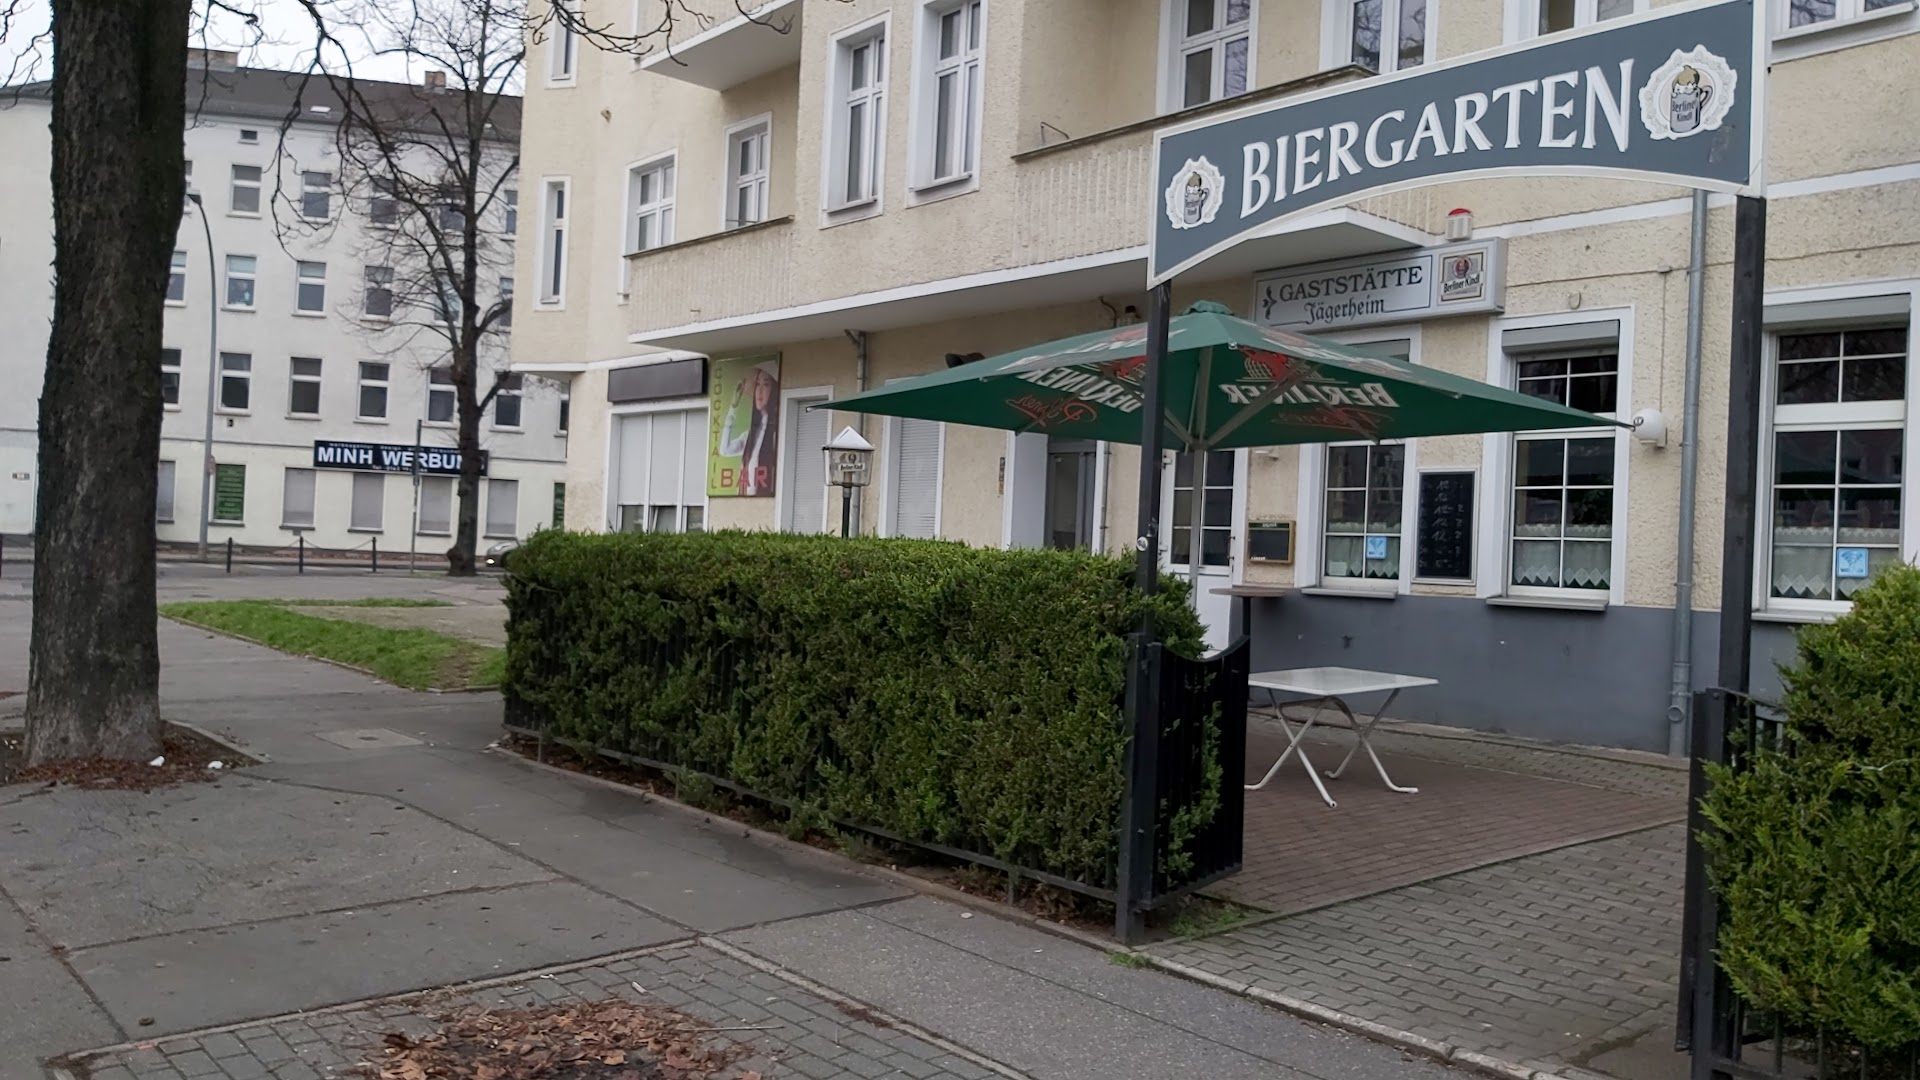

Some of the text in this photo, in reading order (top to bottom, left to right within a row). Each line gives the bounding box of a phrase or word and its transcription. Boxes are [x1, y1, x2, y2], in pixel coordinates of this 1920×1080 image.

[1240, 58, 1635, 219] BIERGARTEN
[1279, 265, 1423, 302] GASTSTÄTTE
[1444, 279, 1464, 293] Berliner
[1303, 296, 1384, 325] Jägerheim
[711, 368, 722, 489] COCKTAIL
[318, 446, 373, 465] MINH
[382, 450, 485, 470] WERBU
[720, 466, 768, 488] BAR
